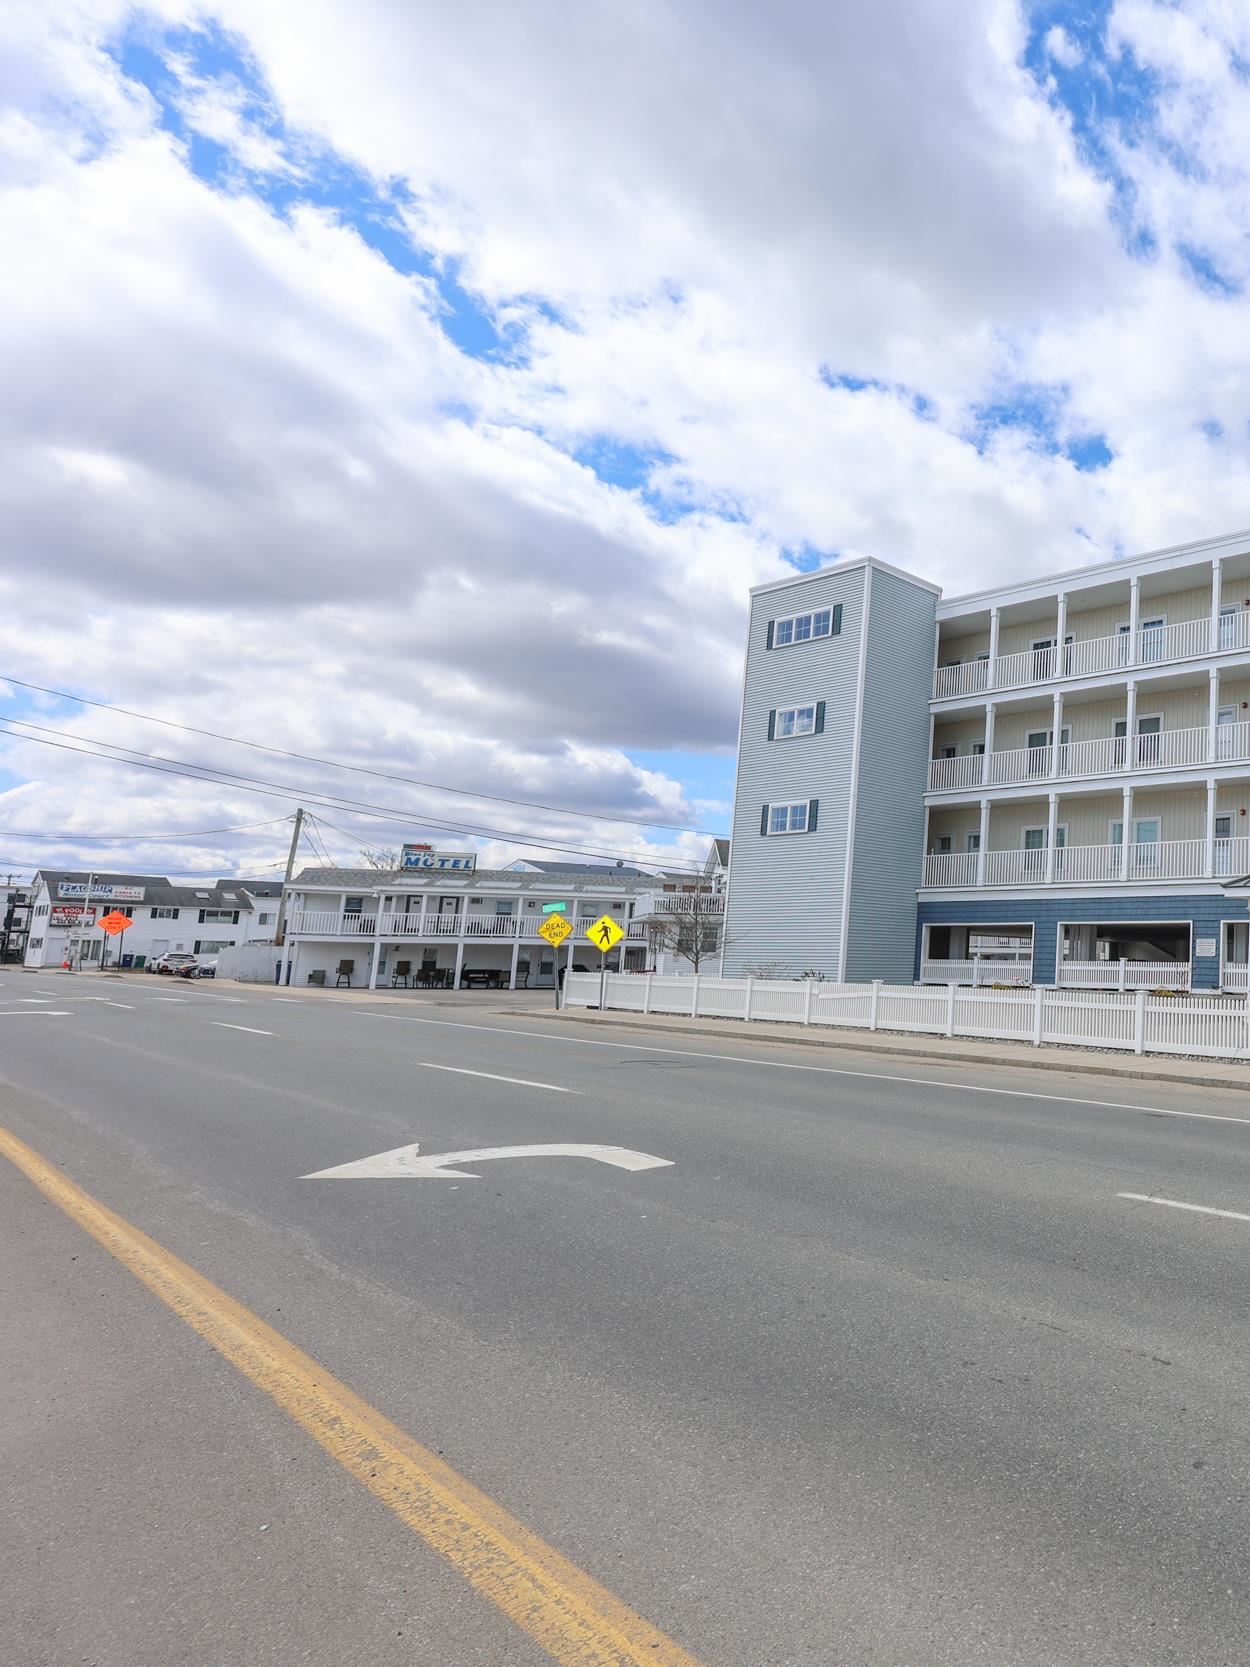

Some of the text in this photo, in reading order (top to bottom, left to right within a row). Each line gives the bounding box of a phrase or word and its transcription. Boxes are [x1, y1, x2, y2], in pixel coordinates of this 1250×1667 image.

[404, 857, 473, 869] MOTEL
[62, 883, 113, 894] FLAGSHIP
[545, 922, 566, 930] DEAD
[548, 931, 564, 939] END
